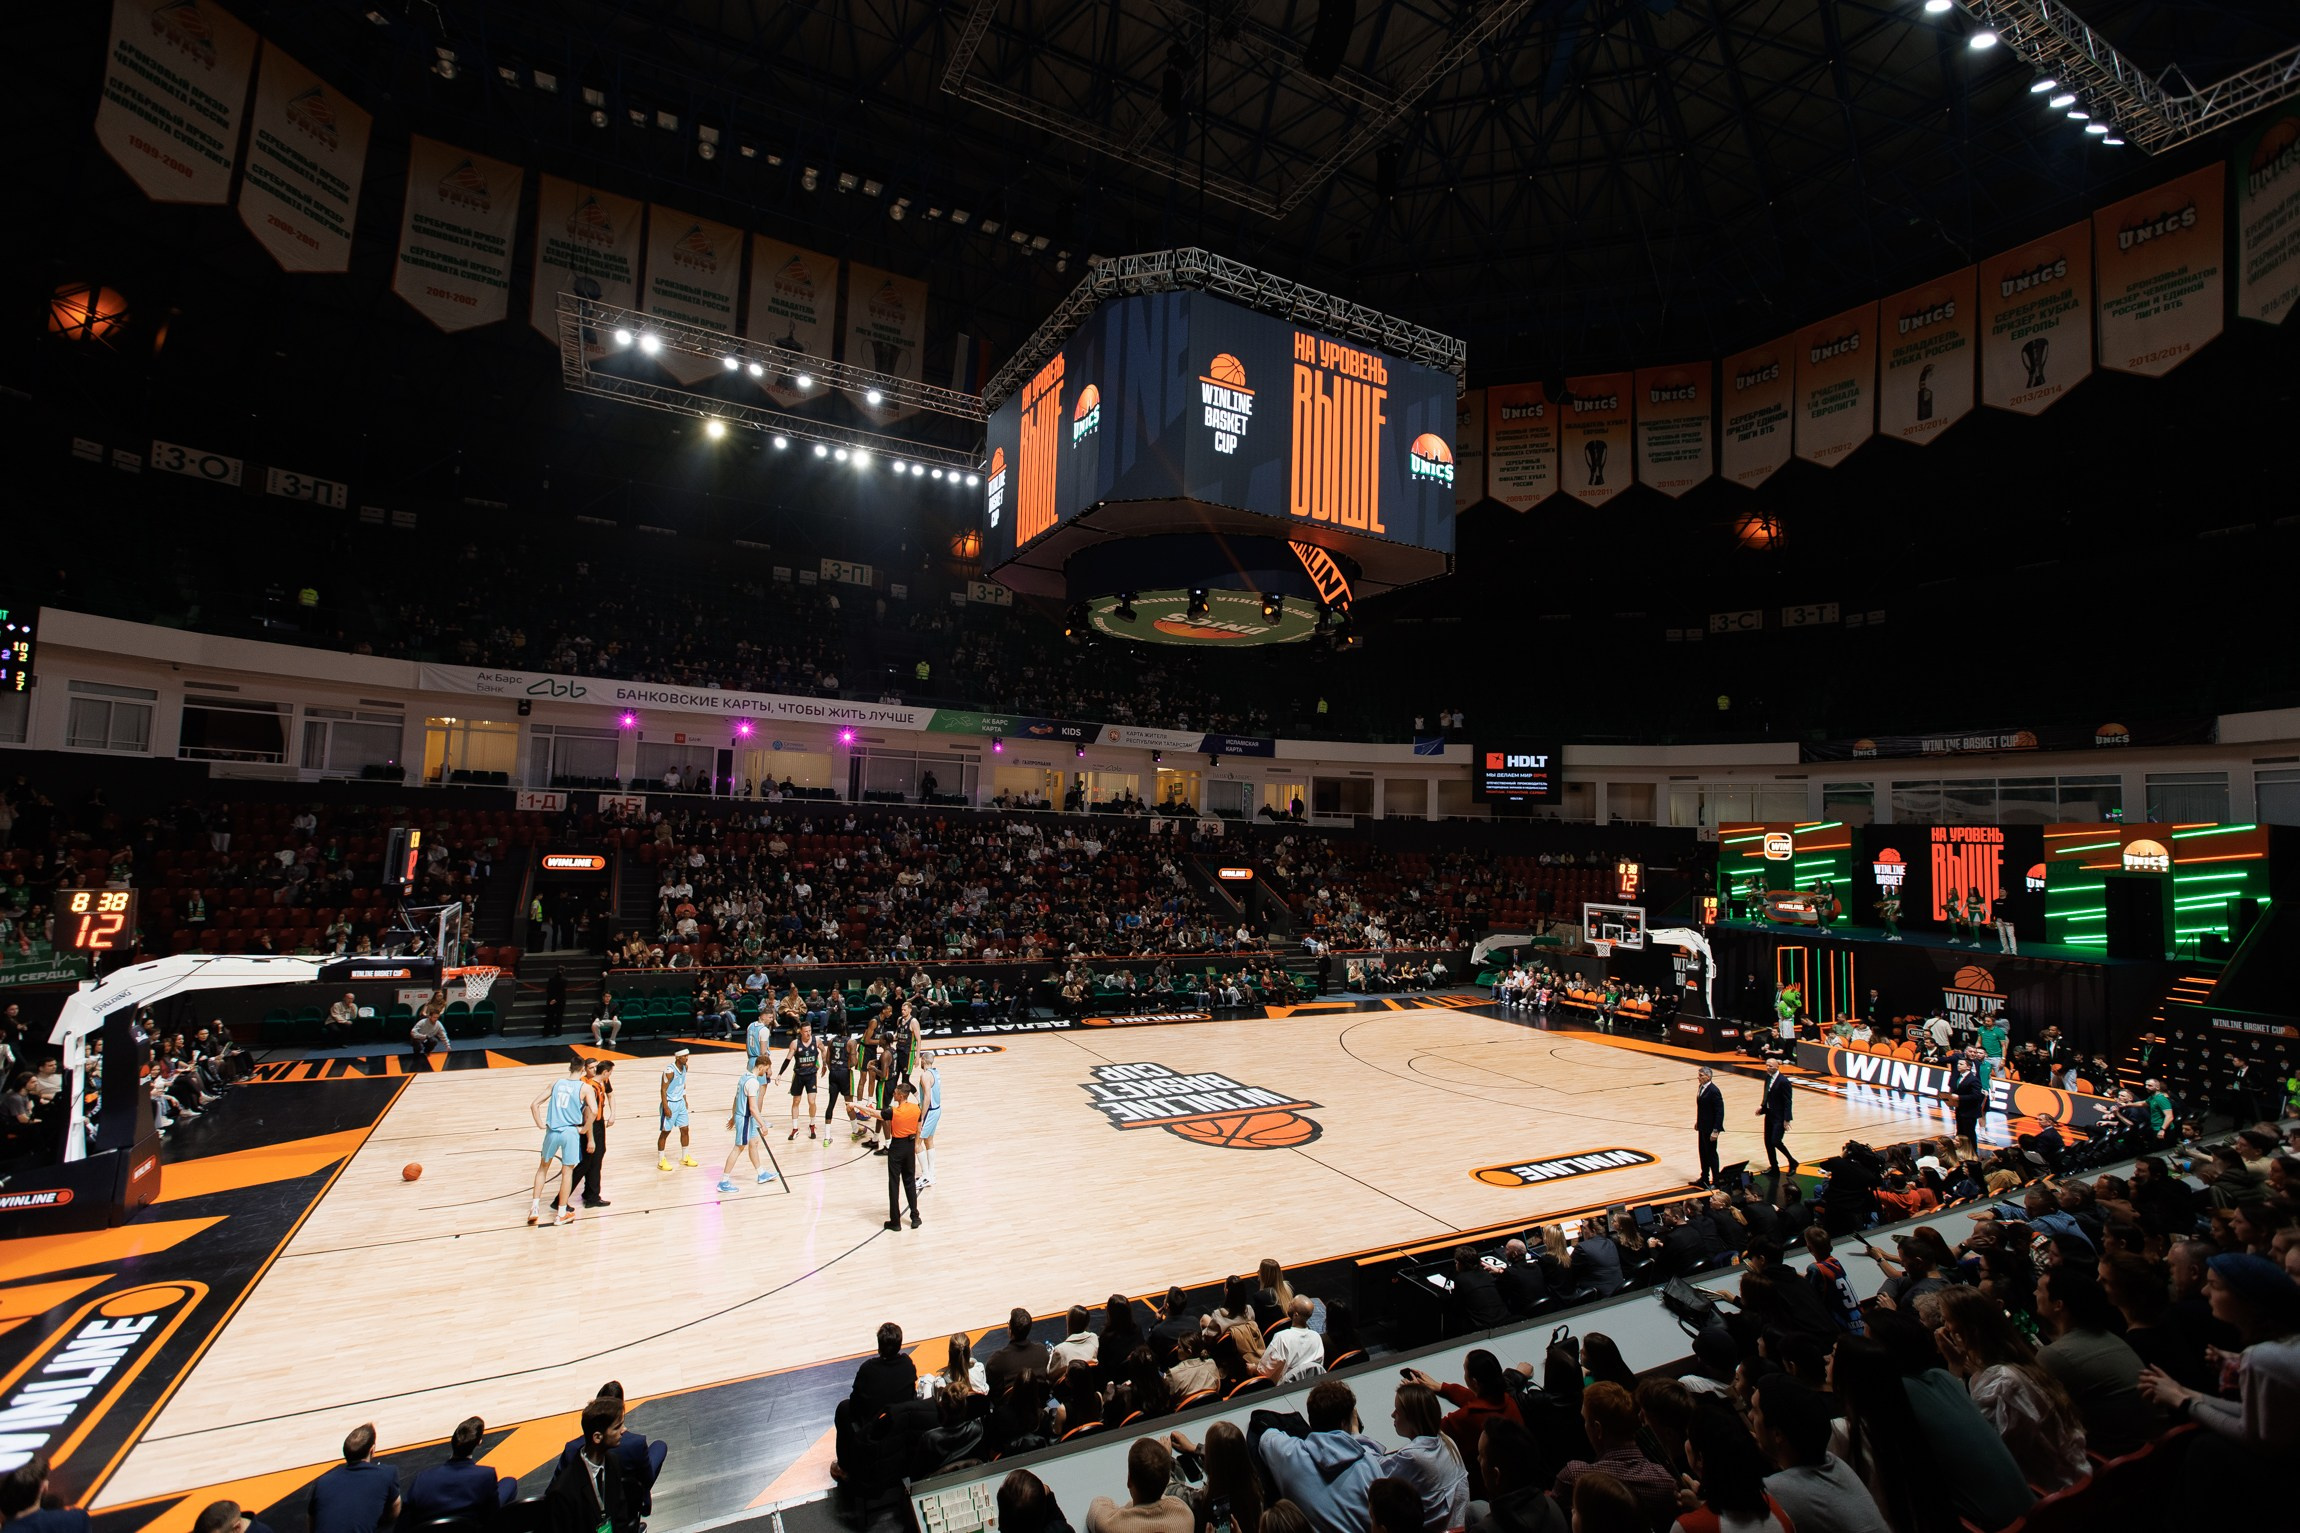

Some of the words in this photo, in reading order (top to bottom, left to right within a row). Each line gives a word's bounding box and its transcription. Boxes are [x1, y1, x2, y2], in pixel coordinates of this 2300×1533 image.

[128, 134, 194, 178] 1999-2000
[267, 214, 320, 250] 2000-2001
[2119, 206, 2196, 250] UNICS
[2001, 259, 2067, 298] UNICS
[2126, 265, 2188, 293] БРОНЗОВЫЙ
[427, 286, 478, 306] 2001-2002
[2103, 293, 2140, 311] ПРИЗЕР
[2143, 267, 2217, 297] ЧЕМПИОНАТОВ
[1995, 288, 2072, 323] СЕРЕБРЯНЫЙ
[2112, 299, 2150, 317] РОССИИ
[2163, 300, 2183, 311] ВТБ
[1899, 302, 1955, 335] UNICS
[1992, 314, 2035, 335] ПРИЗЕР
[2039, 299, 2079, 320] КУБКА
[2011, 318, 2059, 341] ЕВРОПЫ
[1810, 333, 1860, 364] UNICS
[1892, 330, 1959, 357] ОБЛАДАТЕЛЬ
[1294, 331, 1315, 364] НА
[1320, 339, 1388, 386] УРОВЕНЬ
[1889, 351, 1922, 370] КУБКА
[1925, 338, 1965, 358] РОССИИ
[2129, 343, 2190, 367] 2013/2014
[1736, 364, 1779, 390] UNICS
[1201, 382, 1253, 416] WINLINE
[1650, 385, 1696, 404] UNICS
[1811, 379, 1855, 399] УЧАСТНИК
[1821, 387, 1859, 405] ФИНАЛА
[2010, 384, 2062, 407] 2013/2014
[1501, 404, 1544, 420] UNICS
[1574, 396, 1617, 413] UNICS
[1204, 406, 1248, 436] BASKET
[1903, 417, 1948, 436] 2013/2014
[1214, 431, 1238, 455] CUP
[1291, 363, 1388, 534] ВЫШЕ
[1016, 379, 1064, 548] ВЫШЕ
[1410, 453, 1454, 482] UNICS
[13, 641, 29, 652] 10
[18, 652, 28, 662] 2
[476, 683, 504, 693] Банк
[477, 672, 493, 681] Ак
[495, 673, 522, 684] Барс
[616, 688, 718, 708] БАНКОВСКИЕ
[723, 698, 775, 714] КАРТЫ,
[778, 702, 825, 717] ЧТОБЫ
[828, 706, 866, 721] ЖИТЬ
[868, 710, 914, 724] ЛУЧШЕ
[981, 725, 1002, 733] КАРТА
[992, 718, 1009, 726] БАРС
[1061, 727, 1082, 737] KIDS
[1126, 738, 1162, 746] РЕСПУБЛИКИ
[1163, 740, 1193, 749] ТАТАРСТАН
[1144, 732, 1167, 740] ЖИТЕЛЯ
[1225, 739, 1260, 748] ИСЛАМСКАЯ
[1922, 737, 1961, 752] WINLINE
[1963, 735, 1998, 750] BASKET
[2001, 734, 2021, 748] CUP
[2095, 735, 2130, 744] UNICS
[1225, 746, 1243, 754] КАРТА
[1507, 755, 1548, 768] HDLT
[527, 794, 557, 810] 1-Д
[1931, 827, 1947, 842] НА
[1950, 827, 2004, 842] УРОВЕНЬ
[1771, 842, 1790, 851] WIN
[1873, 864, 1906, 875] WINLINE
[2123, 855, 2169, 867] UNICS
[1621, 874, 1638, 892] 12
[1931, 844, 2004, 925] ВЫШЕ
[71, 892, 89, 912] 8
[96, 892, 129, 912] 38
[1704, 908, 1717, 924] 12
[75, 914, 125, 948] 12
[20, 969, 77, 982] СЕРДЦА
[92, 990, 132, 1014] SPALDING
[962, 1019, 1071, 1033] ДЕЛАЕТ
[1110, 1013, 1202, 1025] WINLINE
[834, 1048, 841, 1059] 3
[1099, 1062, 1174, 1082] CUP
[1088, 1072, 1240, 1101] BASKET
[1097, 1086, 1293, 1122] WINLINE
[1511, 1150, 1648, 1181] WINLINE
